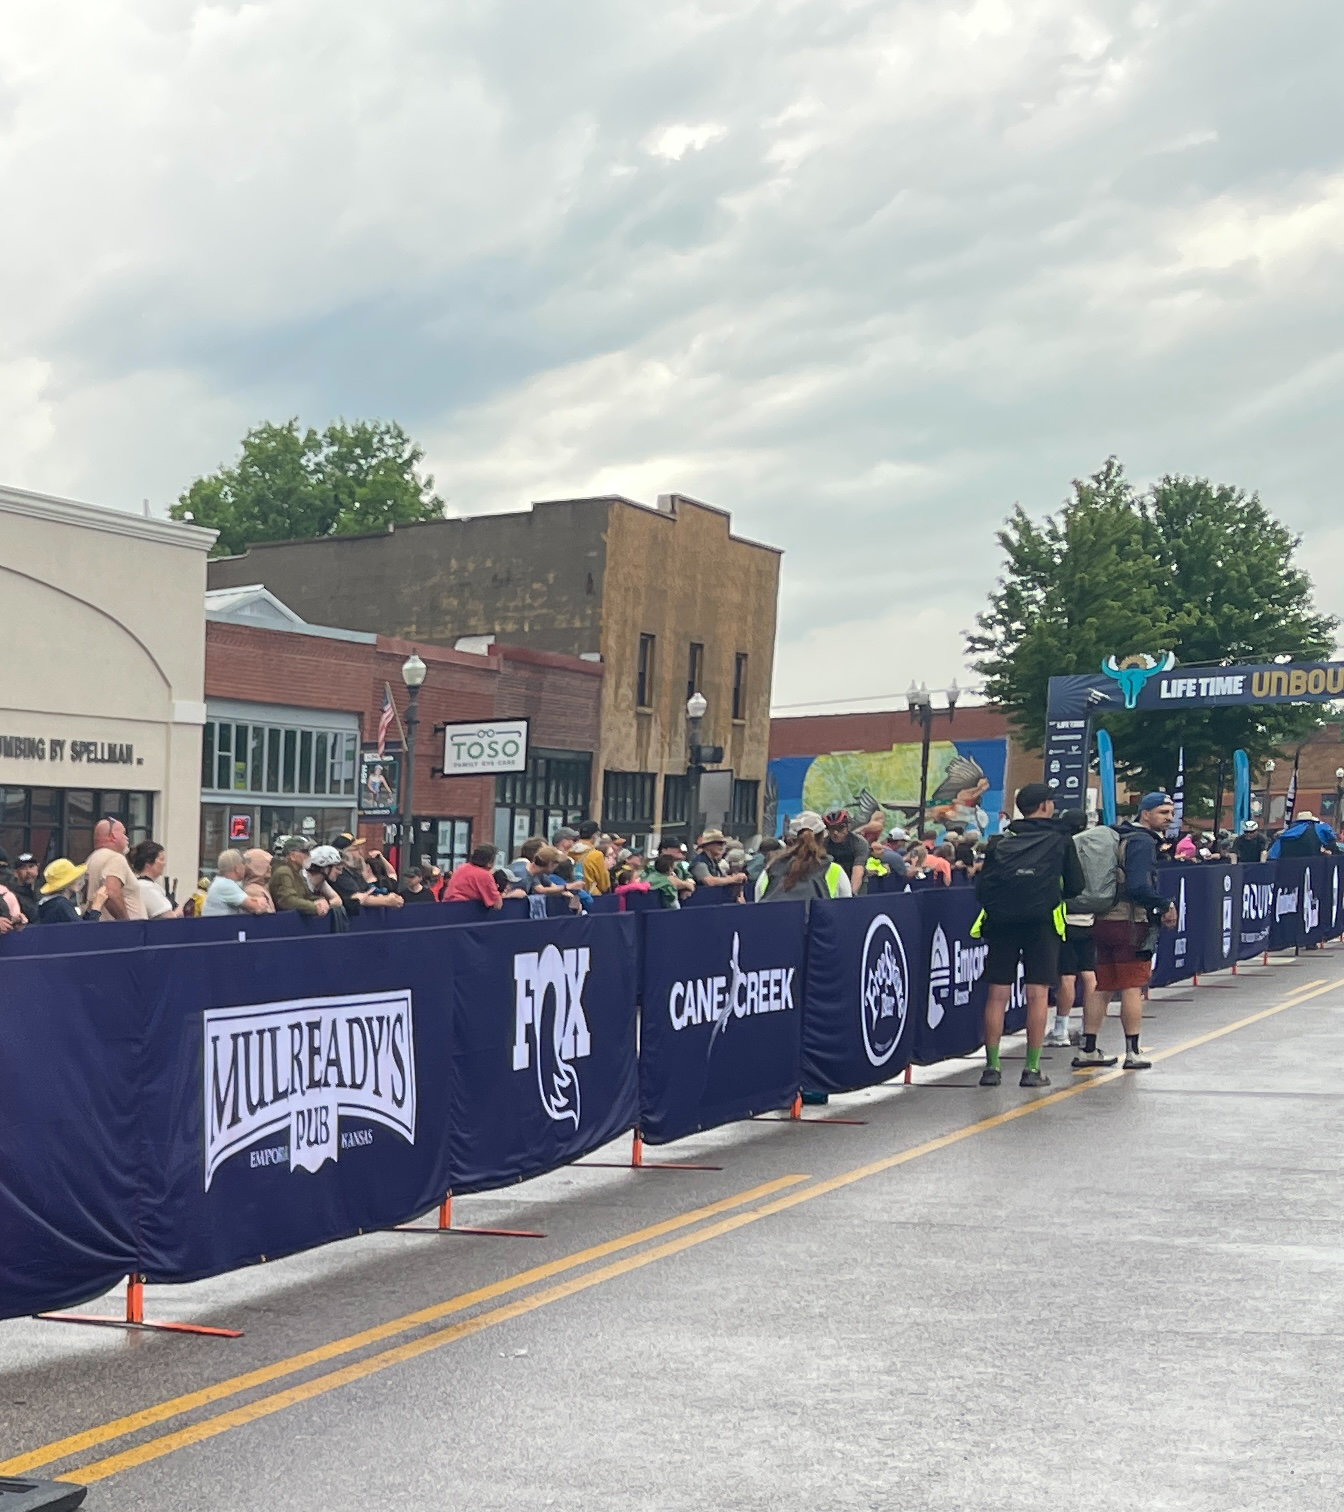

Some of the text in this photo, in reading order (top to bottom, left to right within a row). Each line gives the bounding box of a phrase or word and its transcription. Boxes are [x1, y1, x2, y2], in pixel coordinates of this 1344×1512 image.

[1160, 678, 1197, 699] LIFE
[49, 738, 67, 762] BY
[70, 740, 133, 766] SPELLMAN
[451, 739, 520, 761] TOSO
[513, 943, 591, 1072] FOX
[669, 966, 796, 1031] CANE CREEK
[211, 1013, 408, 1135] MULREADY'S
[295, 1105, 330, 1150] PUB
[341, 1128, 373, 1149] KANSAS
